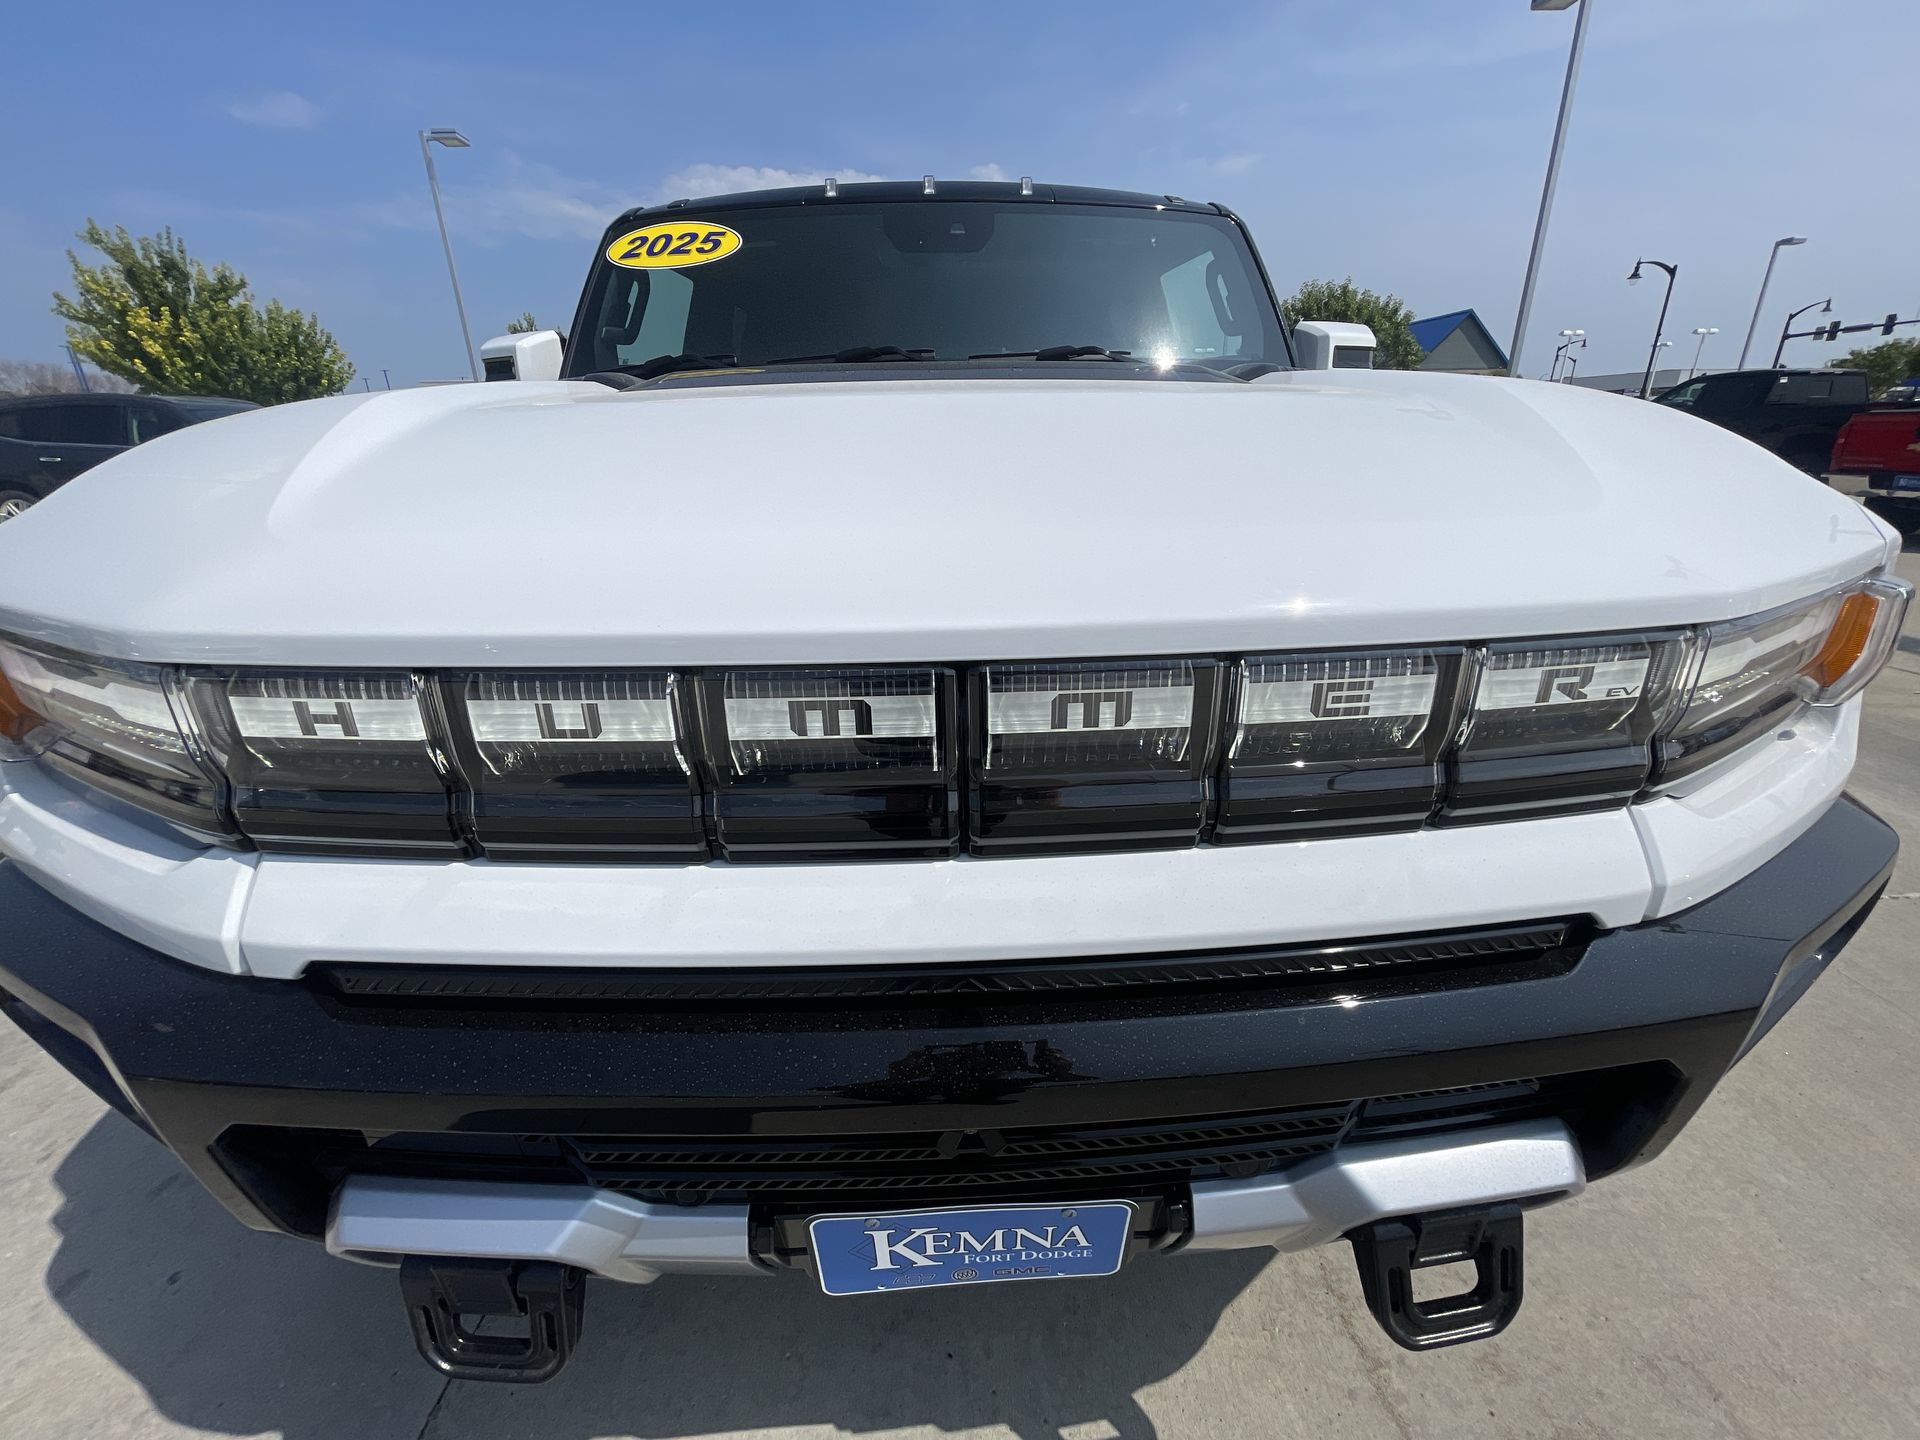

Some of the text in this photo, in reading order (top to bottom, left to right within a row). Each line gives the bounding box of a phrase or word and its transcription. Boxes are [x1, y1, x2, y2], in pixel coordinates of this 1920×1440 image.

[619, 231, 727, 259] 2025
[1605, 686, 1640, 697] EV
[863, 1225, 1092, 1270] KEMNA
[963, 1249, 1093, 1264] FORT DODGE
[995, 1265, 1050, 1275] GMC
